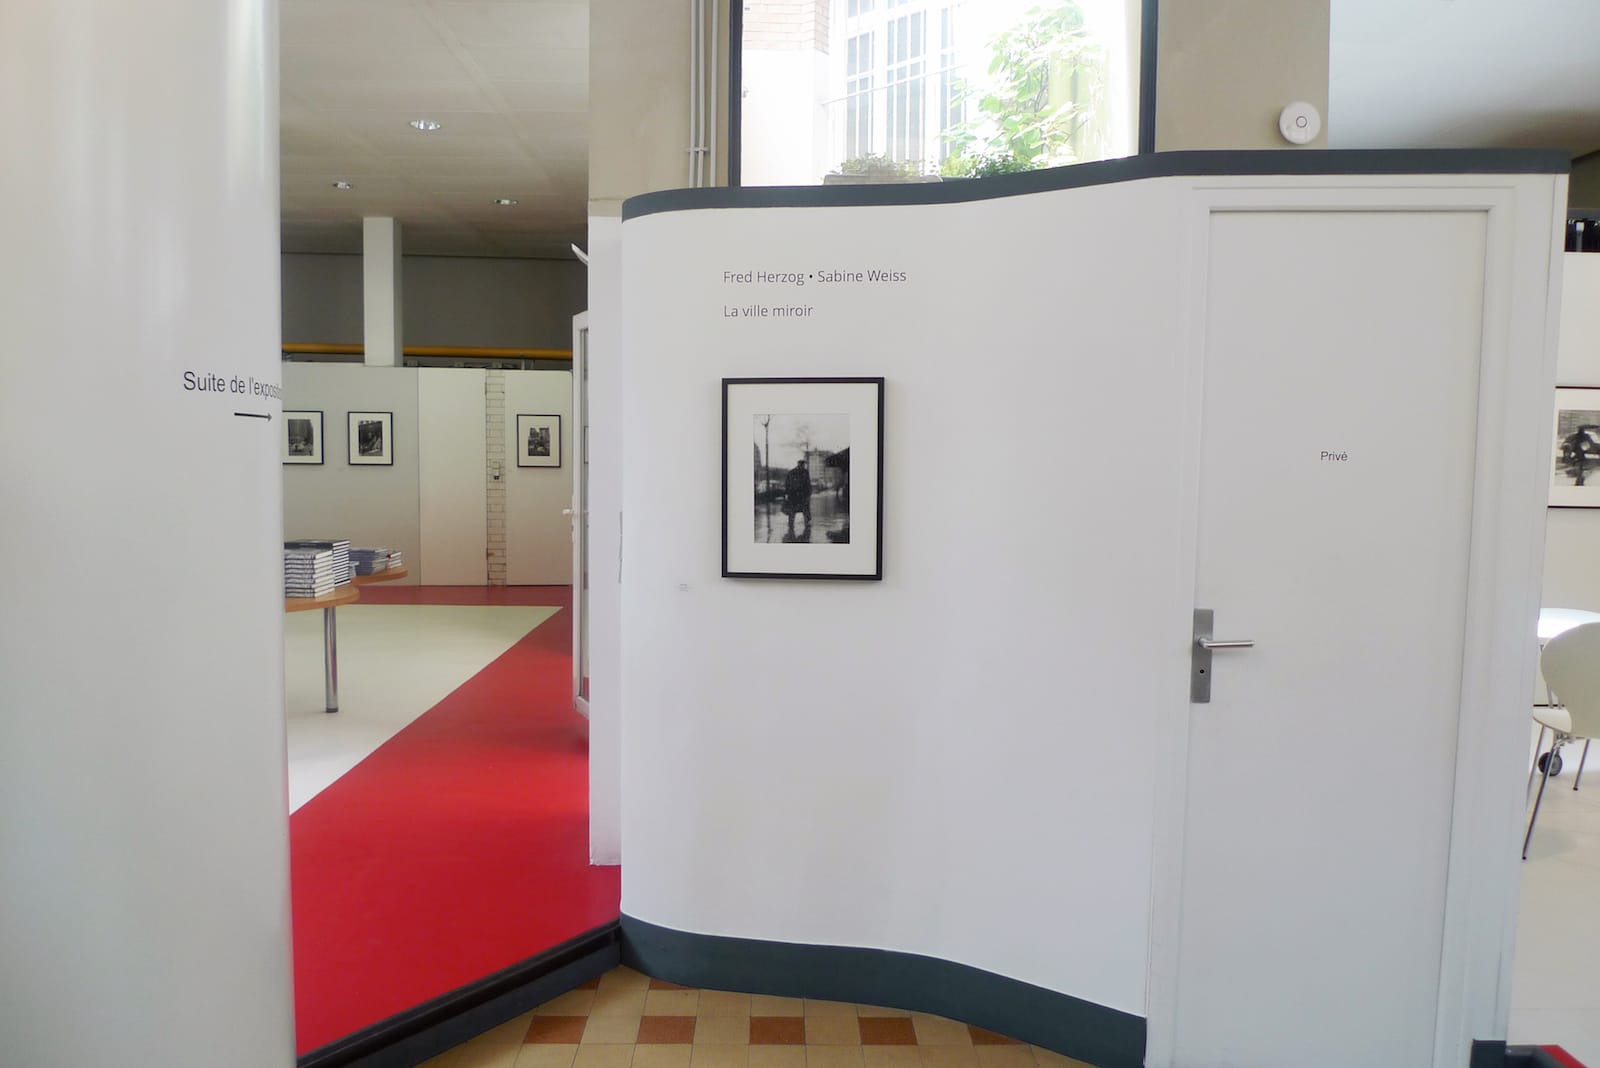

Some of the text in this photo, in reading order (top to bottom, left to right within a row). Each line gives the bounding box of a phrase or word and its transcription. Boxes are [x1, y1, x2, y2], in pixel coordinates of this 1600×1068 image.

[723, 269, 907, 287] Fred Herzog Sabine Weiss
[723, 304, 813, 318] La ville miroir
[183, 370, 226, 392] Suite
[230, 375, 246, 394] de
[1320, 450, 1348, 462] Privé
